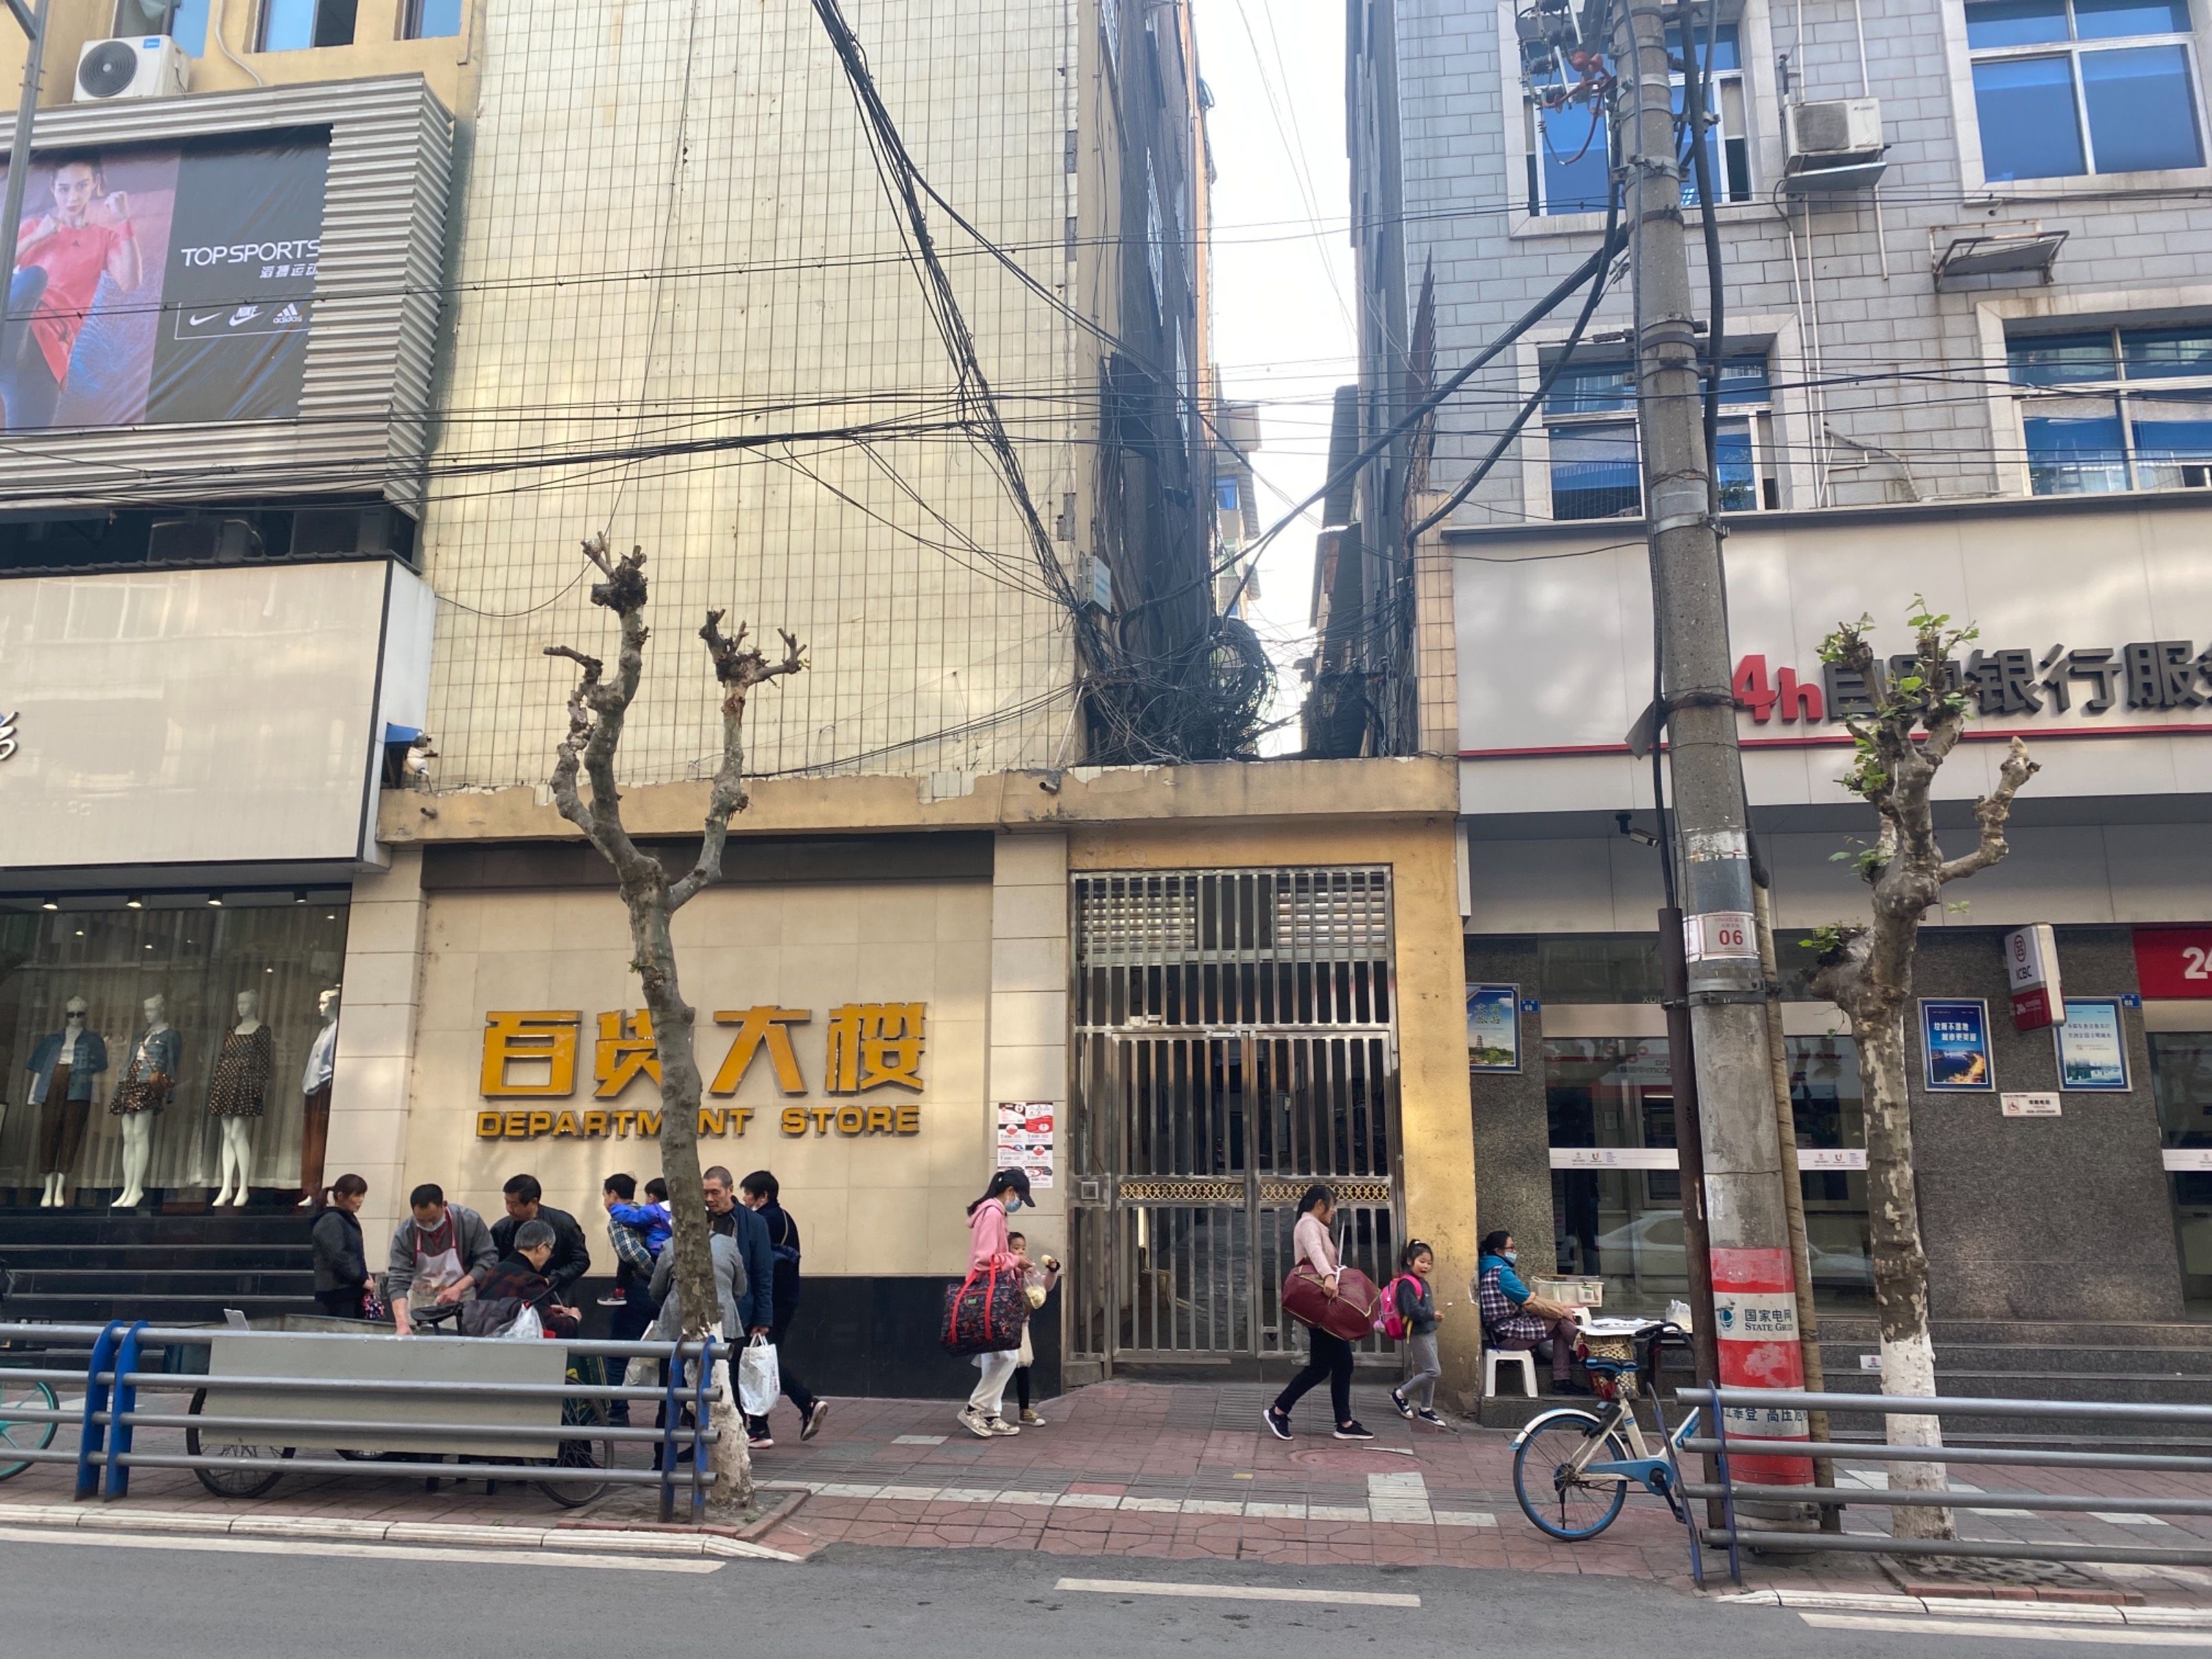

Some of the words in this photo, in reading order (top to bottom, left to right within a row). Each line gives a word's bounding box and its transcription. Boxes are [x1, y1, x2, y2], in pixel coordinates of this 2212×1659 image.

[181, 239, 320, 267] TOPSPORTS
[1719, 930, 1743, 945] 06
[2016, 965, 2032, 981] ICBC
[479, 1002, 927, 1098] 百货大楼
[477, 1108, 753, 1137] DEPARTMNT
[781, 1105, 920, 1134] STORE
[1744, 1322, 1773, 1331] STATE
